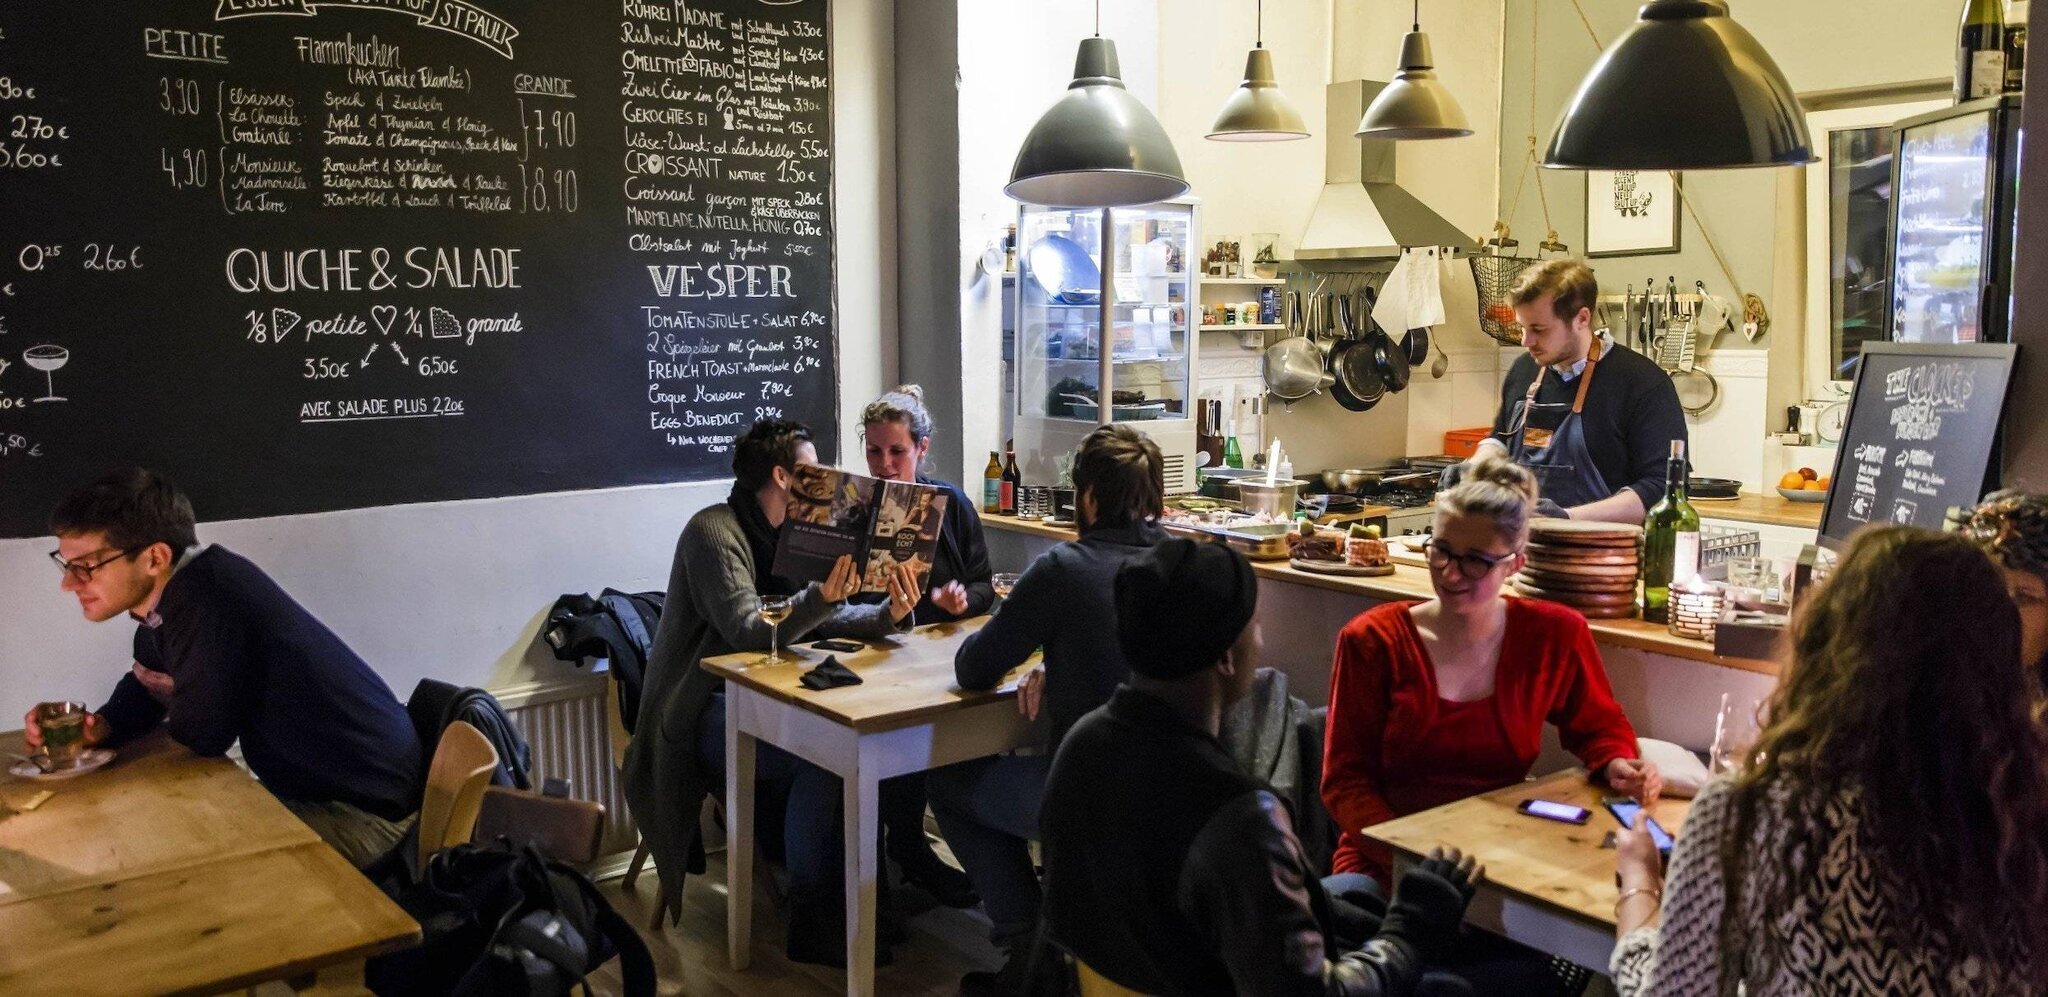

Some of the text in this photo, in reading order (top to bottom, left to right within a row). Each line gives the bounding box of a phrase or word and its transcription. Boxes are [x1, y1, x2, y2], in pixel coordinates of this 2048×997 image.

[675, 0, 727, 29] MADAME
[144, 28, 228, 60] PETITE
[294, 32, 400, 69] Flammkuchen
[621, 22, 725, 52] Rührei Maître
[622, 49, 683, 76] OMELETTE
[700, 59, 735, 79] FABIO
[160, 77, 200, 116] 3,90
[514, 73, 573, 94] GRANDE
[621, 71, 660, 99] Zwei
[661, 78, 692, 101] Eier
[693, 86, 713, 103] im
[716, 86, 742, 112] Glas
[393, 94, 443, 111] Zwiebeln
[623, 101, 708, 126] GEKOCHTES EI
[228, 107, 248, 123] La
[328, 113, 360, 132] Apfel
[381, 114, 435, 132] Thymian
[457, 117, 494, 136] Honig
[533, 109, 576, 149] 7,90
[323, 130, 372, 145] Tomate
[732, 136, 796, 160] Lachsteller
[162, 147, 207, 190] 4,90
[230, 153, 301, 173] Monsieur
[323, 156, 380, 174] Roquefort
[394, 158, 446, 174] Schinken
[625, 150, 722, 179] CROISSANT
[729, 170, 766, 182] NATURE
[323, 174, 394, 189] Ziegenkäse
[475, 174, 510, 190] Rauke
[533, 167, 578, 213] 8,90
[624, 176, 696, 201] Croissant
[751, 197, 766, 206] MIT
[767, 197, 791, 208] SPECK
[235, 193, 254, 212] La
[255, 192, 287, 212] Terre
[322, 191, 388, 207] Kartoffel
[753, 218, 790, 234] HONIG
[629, 233, 769, 260] Obstsalat mit Joghurt
[226, 247, 522, 292] QUICHE & SALADE
[646, 262, 797, 299] VESPER
[306, 312, 367, 341] petite
[466, 312, 523, 346] grande
[641, 306, 750, 329] TOMATENSTULLE
[761, 312, 798, 328] SALAT
[647, 331, 660, 353] 2
[728, 338, 743, 353] mit
[648, 360, 699, 380] FRENCH
[701, 360, 743, 376] TOAST
[301, 401, 331, 417] AVEC
[338, 399, 389, 416] SALADE
[395, 398, 427, 413] PLUS
[648, 383, 687, 413] Croque
[651, 410, 743, 430] EGGS BENEDICT
